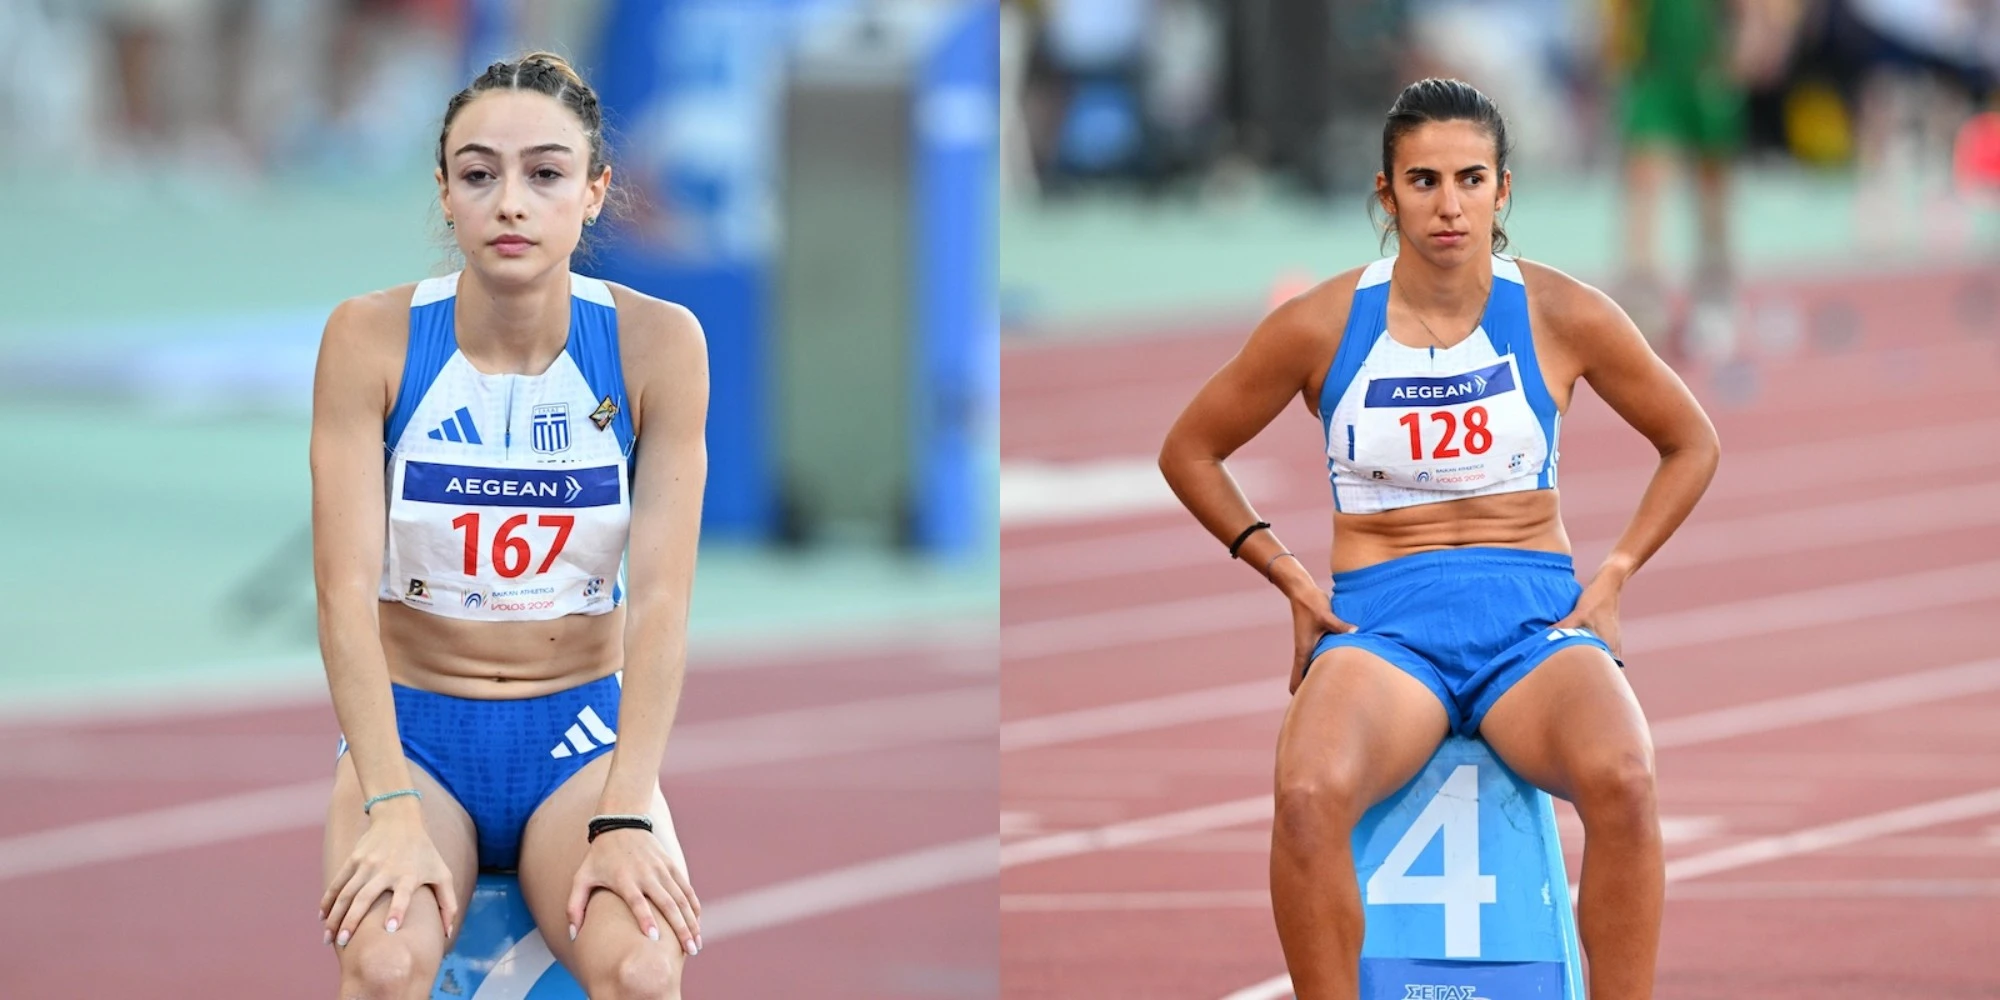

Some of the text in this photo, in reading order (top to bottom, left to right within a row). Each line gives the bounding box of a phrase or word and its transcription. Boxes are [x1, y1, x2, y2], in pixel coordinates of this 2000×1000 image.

[1392, 382, 1472, 399] AEGEAN
[1400, 406, 1493, 460] 128
[445, 478, 557, 497] AEGEAN
[452, 512, 575, 578] 167
[492, 587, 554, 598] BALKAN ATHLETICS
[491, 603, 525, 611] VOLOS
[1367, 765, 1496, 957] 4
[1405, 984, 1476, 1000] ΣΕΓΑΣ
